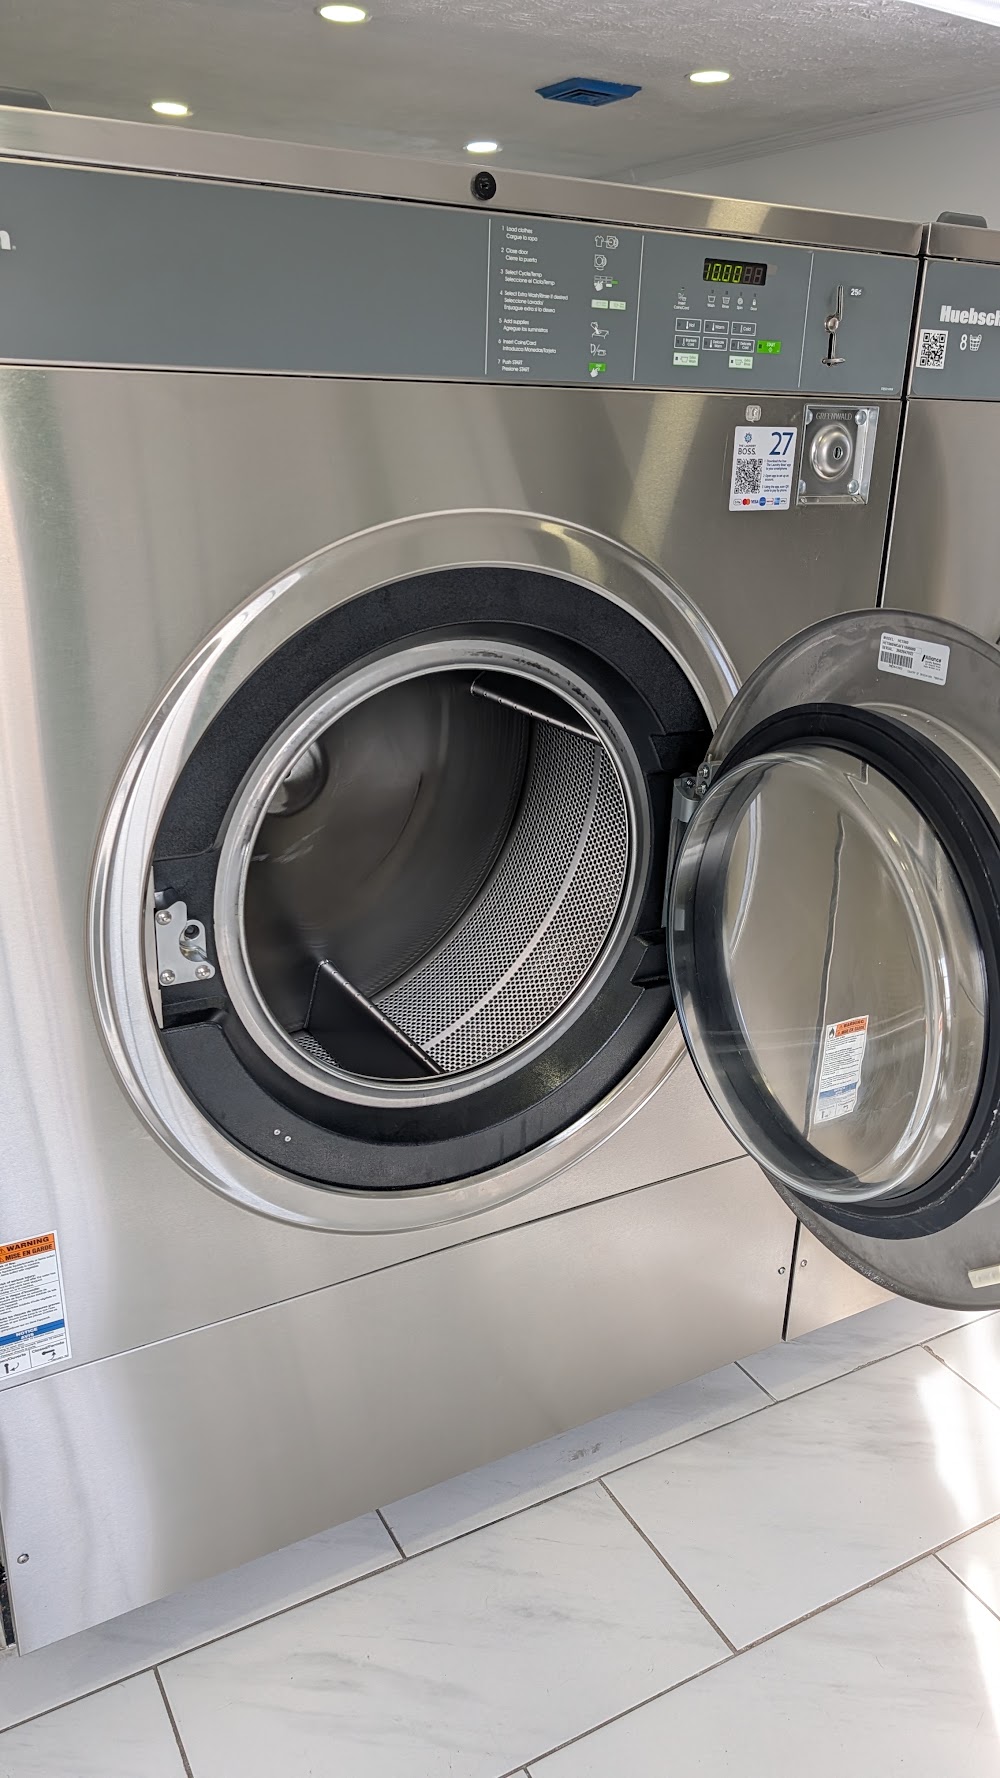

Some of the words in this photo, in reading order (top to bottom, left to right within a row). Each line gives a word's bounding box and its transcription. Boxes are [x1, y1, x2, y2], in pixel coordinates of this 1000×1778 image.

[705, 263, 742, 283] 10.00
[960, 334, 968, 350] 8
[816, 412, 853, 420] GREENWALD
[769, 432, 794, 456] 27
[6, 1236, 50, 1252] WARNING
[5, 1252, 21, 1261] MISE
[32, 1244, 52, 1254] GARDE
[16, 1327, 38, 1337] NOTICE
